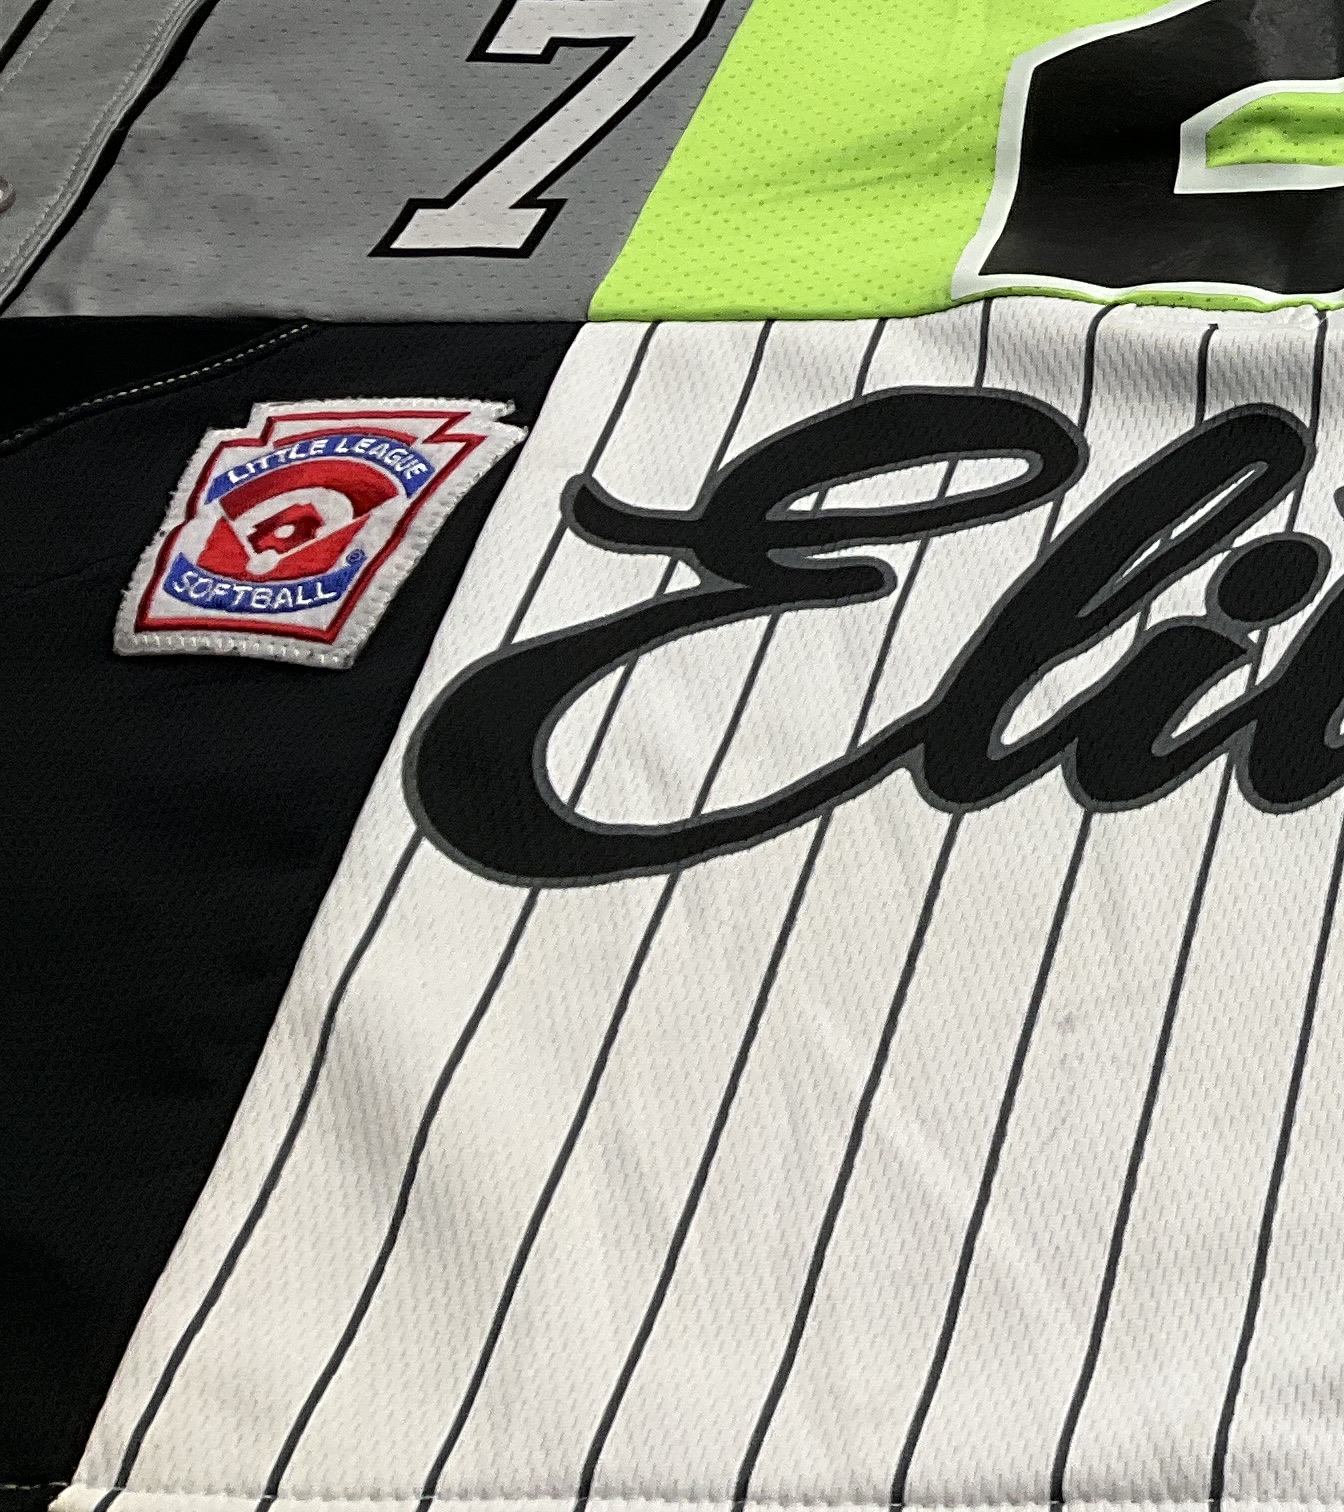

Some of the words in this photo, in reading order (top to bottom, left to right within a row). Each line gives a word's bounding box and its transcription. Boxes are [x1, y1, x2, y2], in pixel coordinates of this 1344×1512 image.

[228, 436, 327, 484] LITTLE
[334, 435, 426, 481] LEAGUE
[172, 570, 340, 610] SOFTBALL
